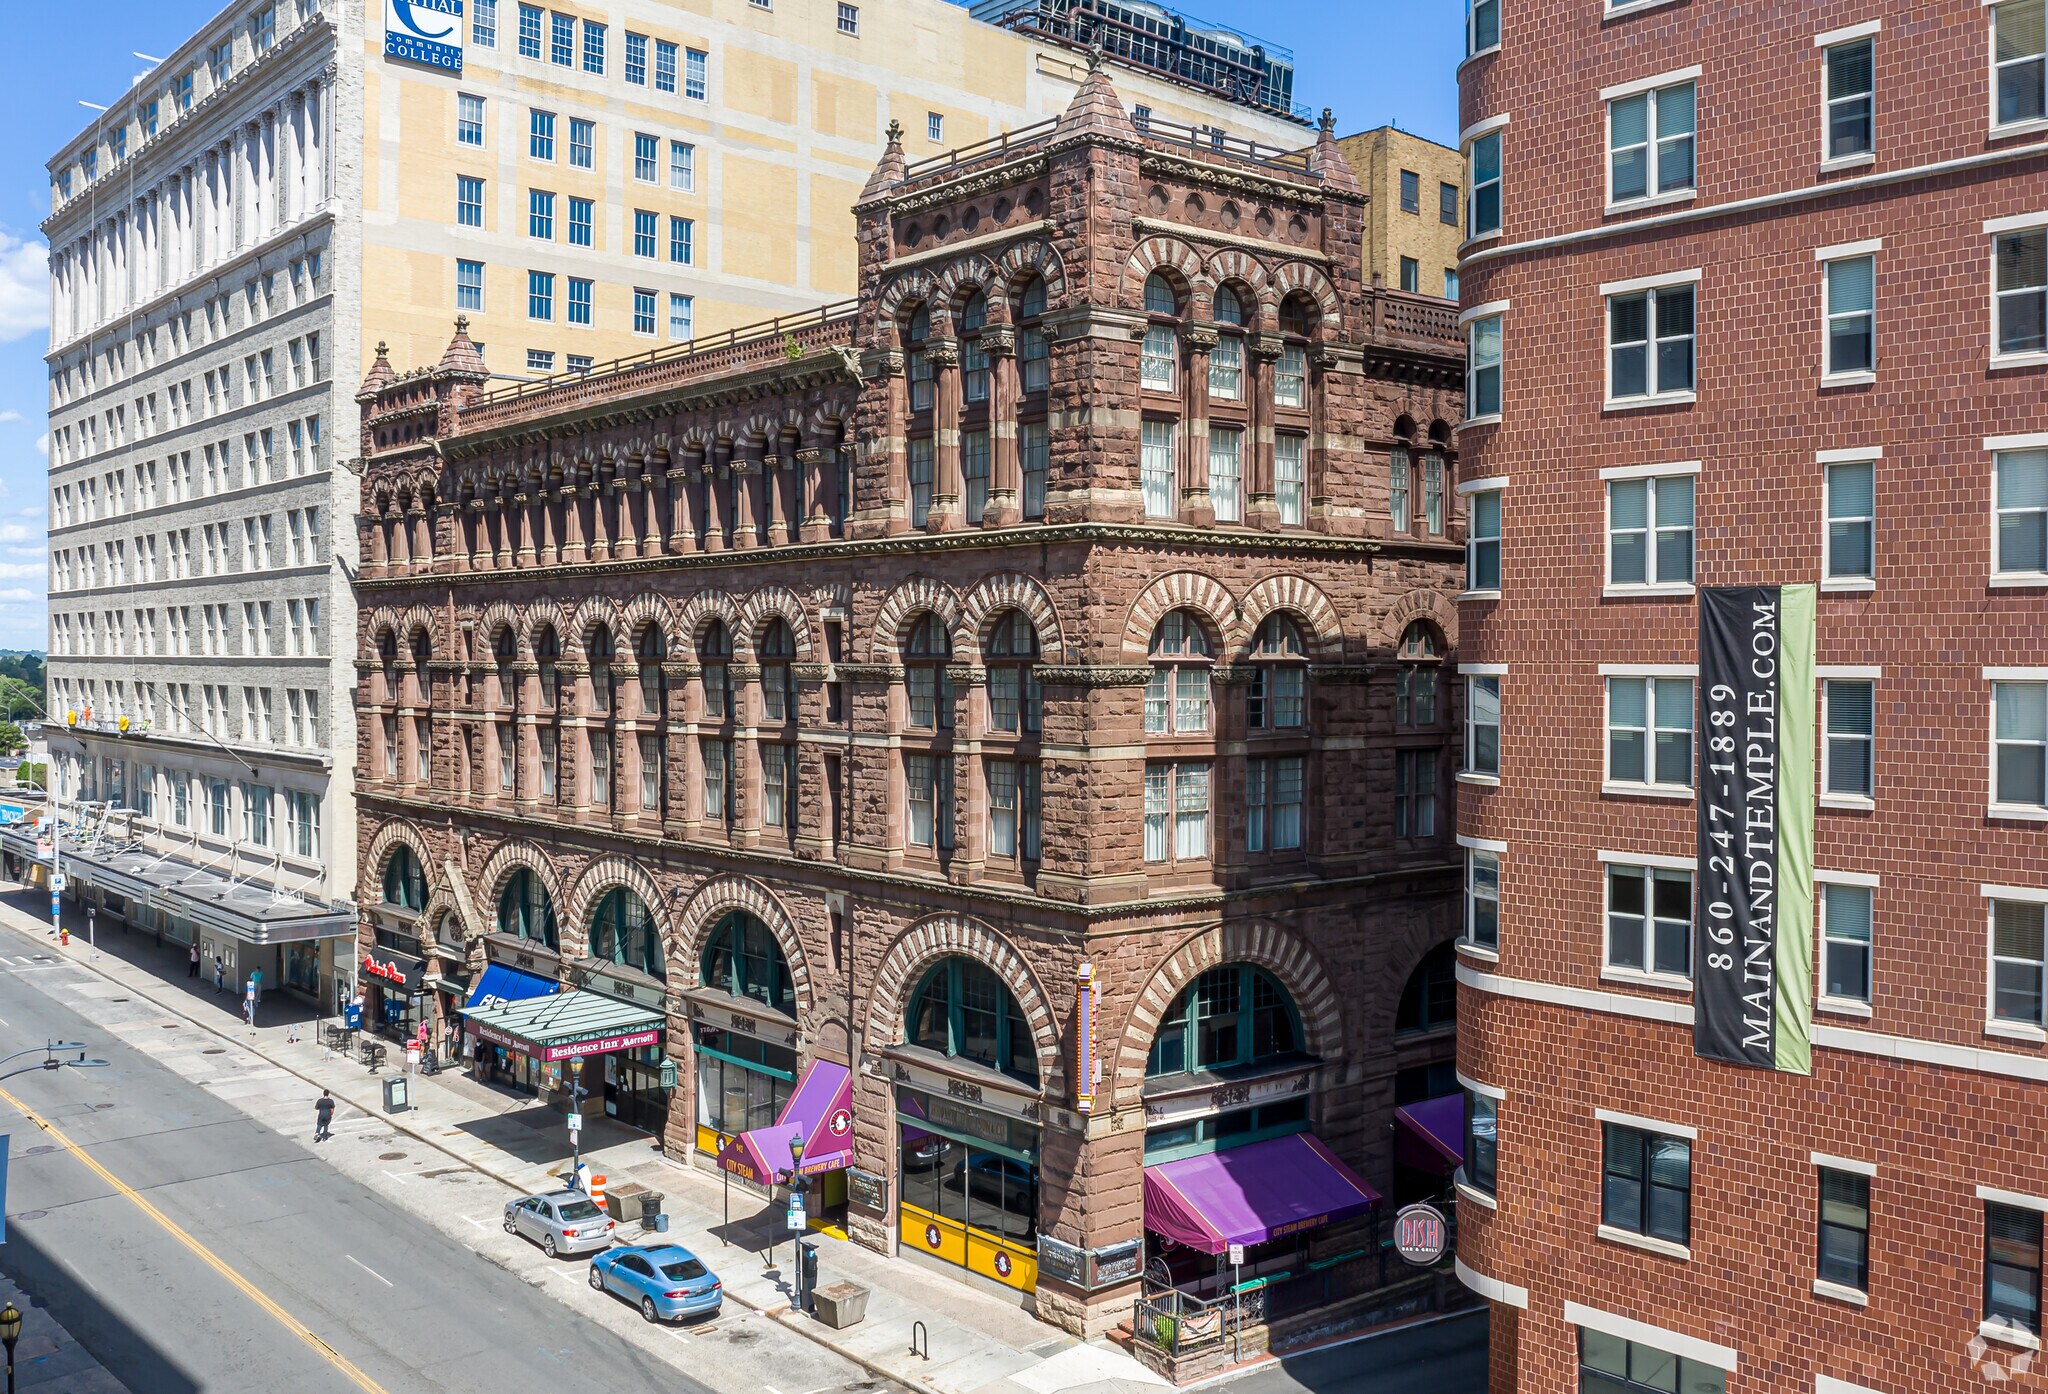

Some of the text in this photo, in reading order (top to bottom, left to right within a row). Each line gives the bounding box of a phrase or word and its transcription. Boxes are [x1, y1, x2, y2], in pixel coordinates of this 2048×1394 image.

[386, 32, 462, 58] Community
[386, 42, 462, 69] COLLEGE
[1707, 683, 1736, 971] 860-247-1889
[1742, 601, 1776, 1053] MAINANDTEMPLE.COM
[479, 1026, 502, 1042] Residence
[502, 1032, 512, 1045] Inn
[551, 1033, 653, 1058] Residence Inn Marriott
[726, 1159, 753, 1180] CITY STEAM
[804, 1162, 828, 1174] BREWERY
[828, 1159, 840, 1169] CAFE
[1402, 1219, 1438, 1248] DISH
